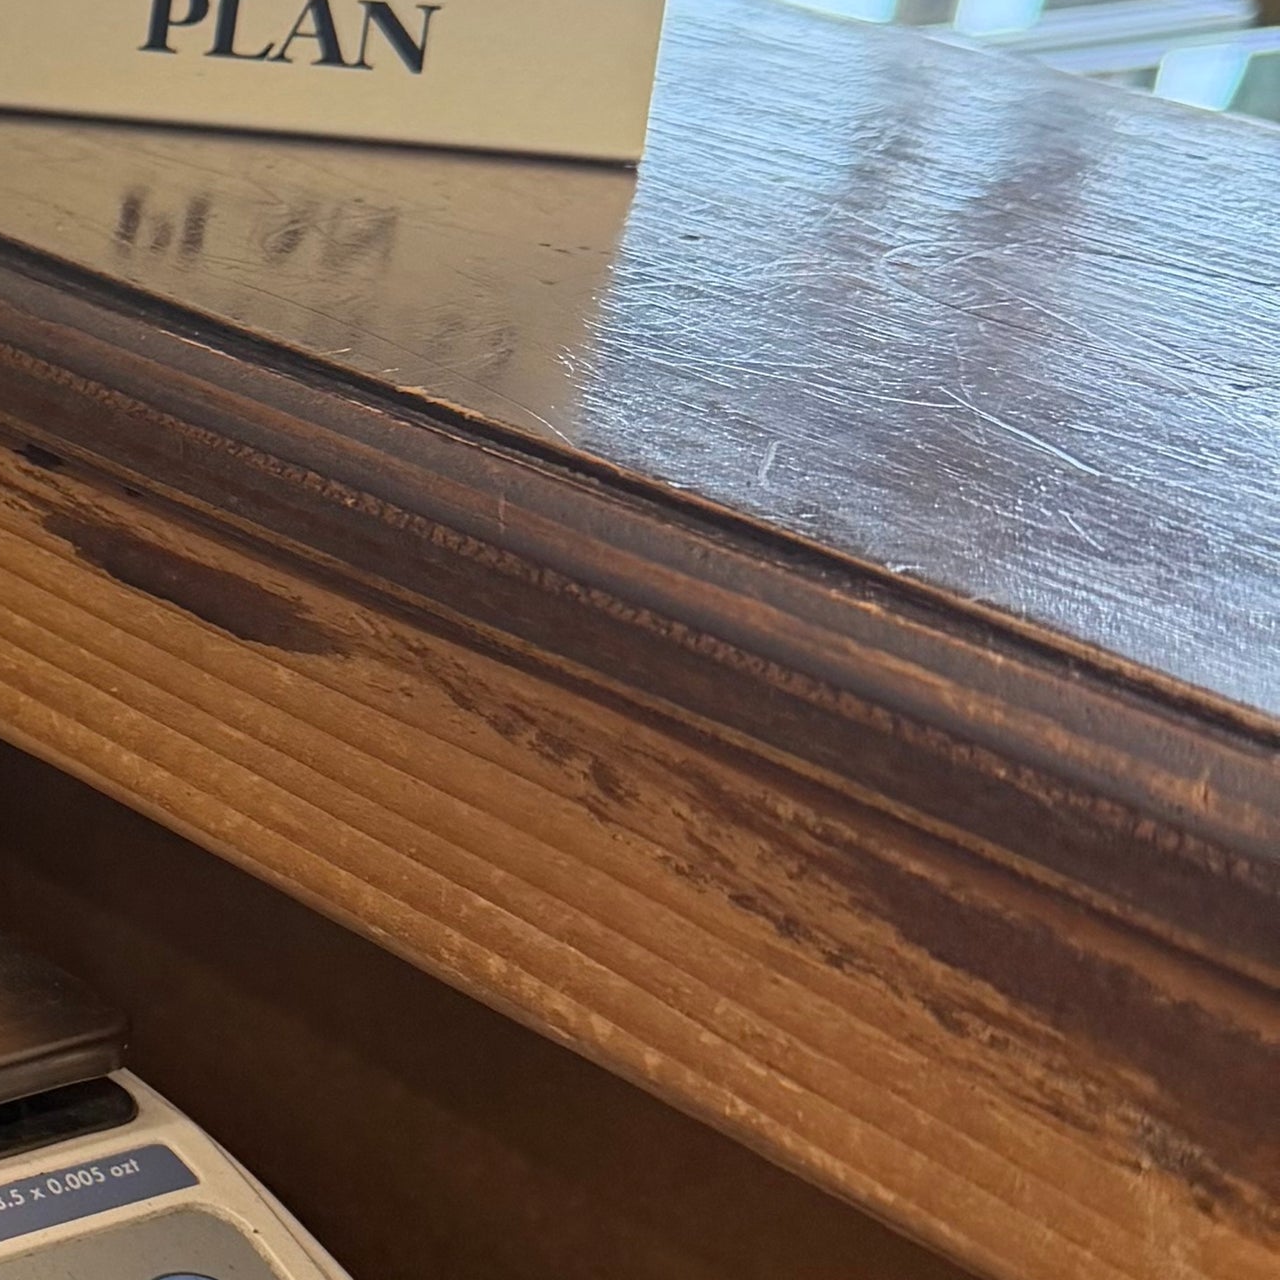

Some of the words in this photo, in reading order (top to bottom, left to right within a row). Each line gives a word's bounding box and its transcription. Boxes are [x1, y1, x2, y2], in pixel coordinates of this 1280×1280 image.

[30, 1184, 46, 1201] x
[46, 1166, 106, 1196] 0.005
[110, 1158, 141, 1180] ozt
